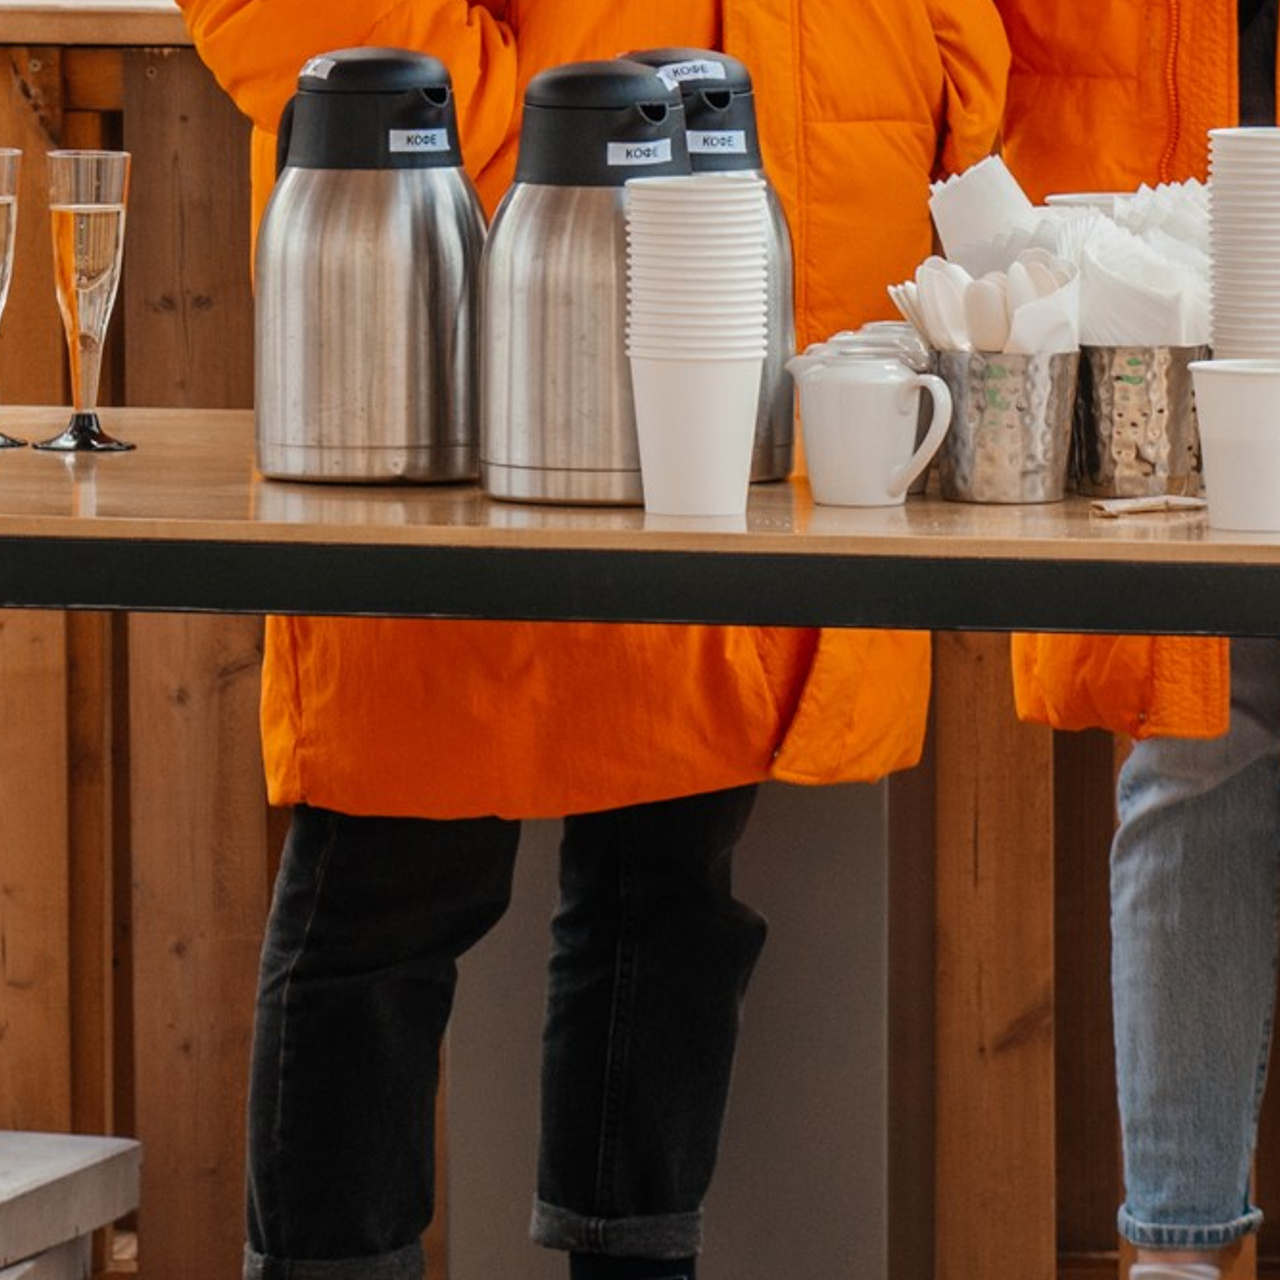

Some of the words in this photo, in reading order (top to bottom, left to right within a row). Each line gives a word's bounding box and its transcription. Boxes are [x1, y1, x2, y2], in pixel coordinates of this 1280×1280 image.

[672, 64, 709, 78] КОФЕ
[405, 133, 437, 147] КОФЕ
[702, 135, 735, 148] КОФЕ
[625, 146, 659, 160] КОФЕ
